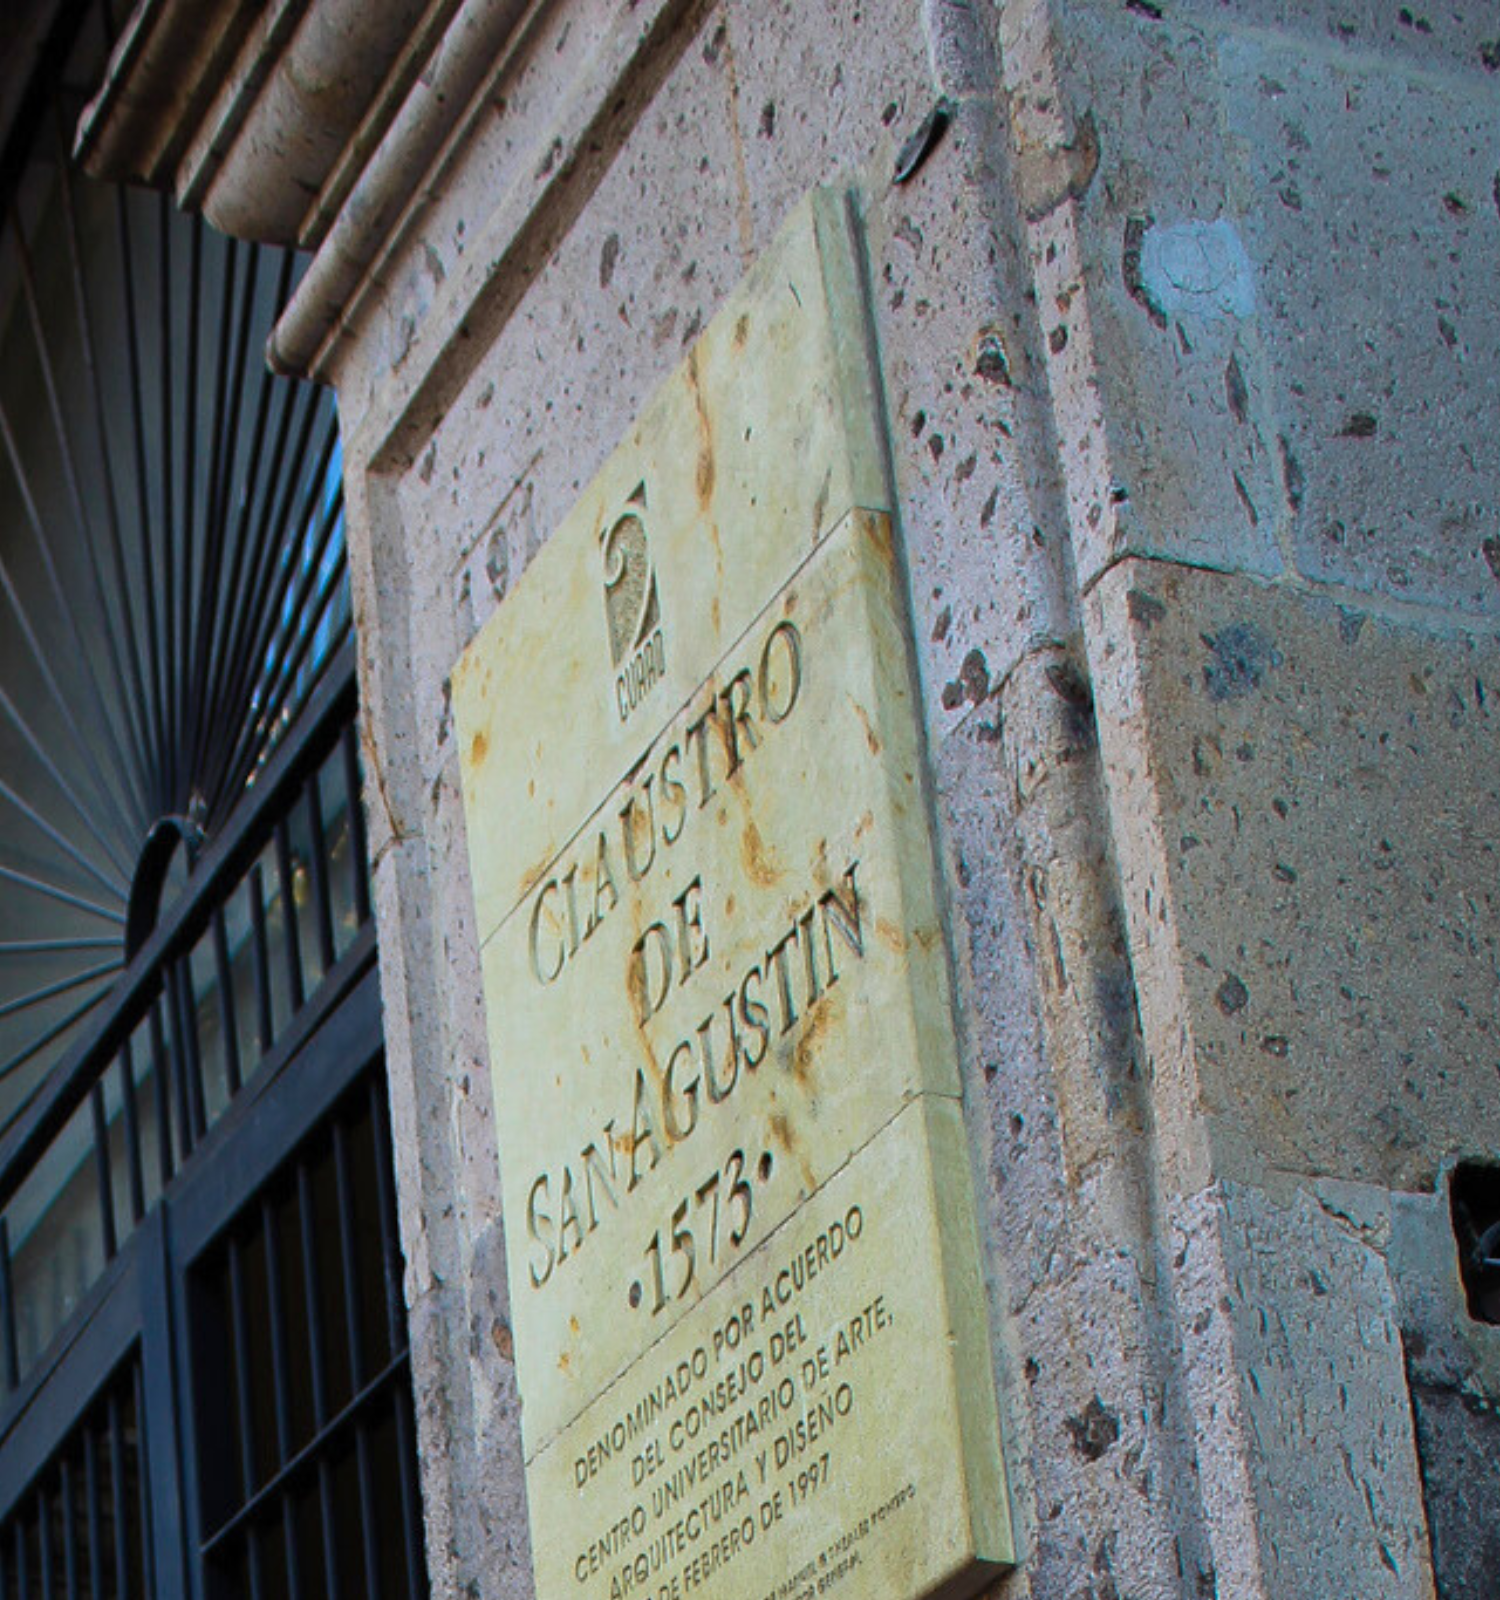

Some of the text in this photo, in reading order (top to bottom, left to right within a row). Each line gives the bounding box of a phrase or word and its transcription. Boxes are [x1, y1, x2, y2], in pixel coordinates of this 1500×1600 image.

[529, 620, 805, 987] CLAUSTRO
[631, 873, 710, 1029] DE
[574, 1205, 862, 1488] DENOMINADO POR ACUERDO
[631, 1309, 806, 1488] DEL CONSEJO DEL
[755, 1449, 768, 1486] Y
[774, 1383, 853, 1470] DISEÑO
[574, 1294, 893, 1582] CENTRO UNIVERSITARIO DE ARTE,
[682, 1518, 754, 1594] FEBRERO
[759, 1491, 782, 1533] DE
[788, 1455, 831, 1507] 1997
